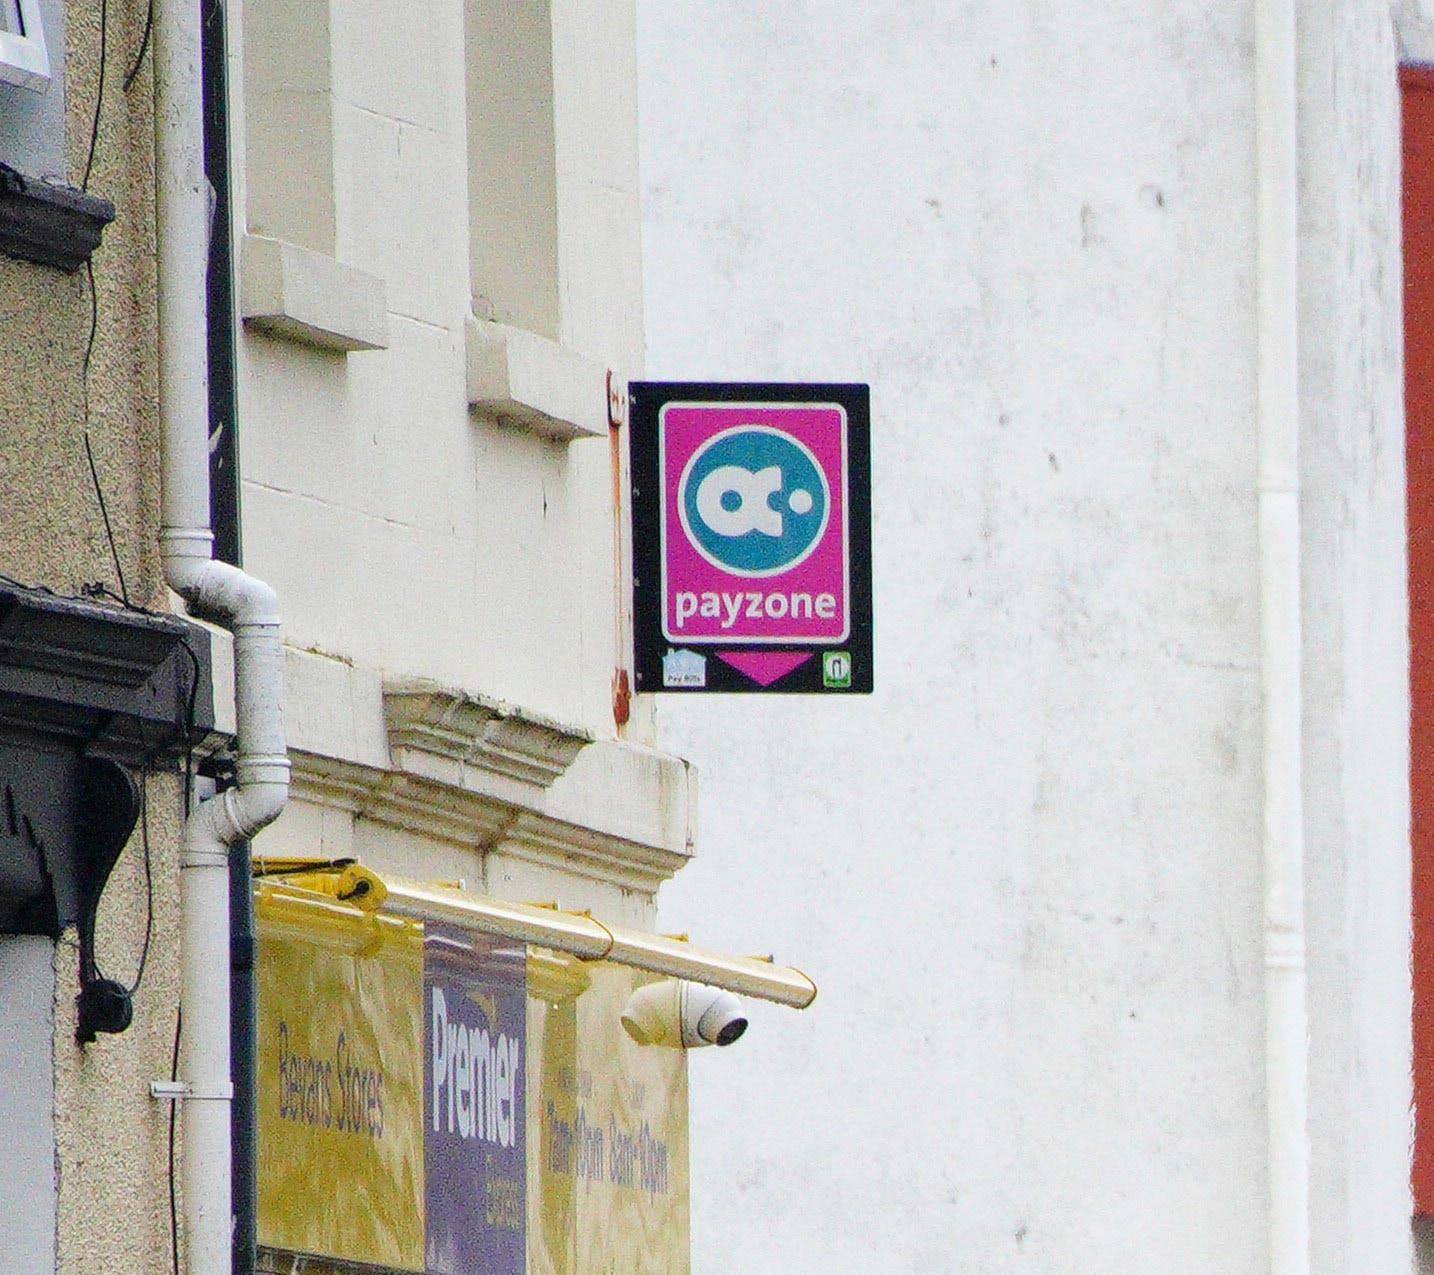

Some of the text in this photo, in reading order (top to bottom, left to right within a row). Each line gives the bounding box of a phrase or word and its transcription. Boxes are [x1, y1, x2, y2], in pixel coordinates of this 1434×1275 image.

[675, 589, 836, 629] payzone
[336, 1029, 384, 1139] Stores
[432, 987, 519, 1148] Premier
